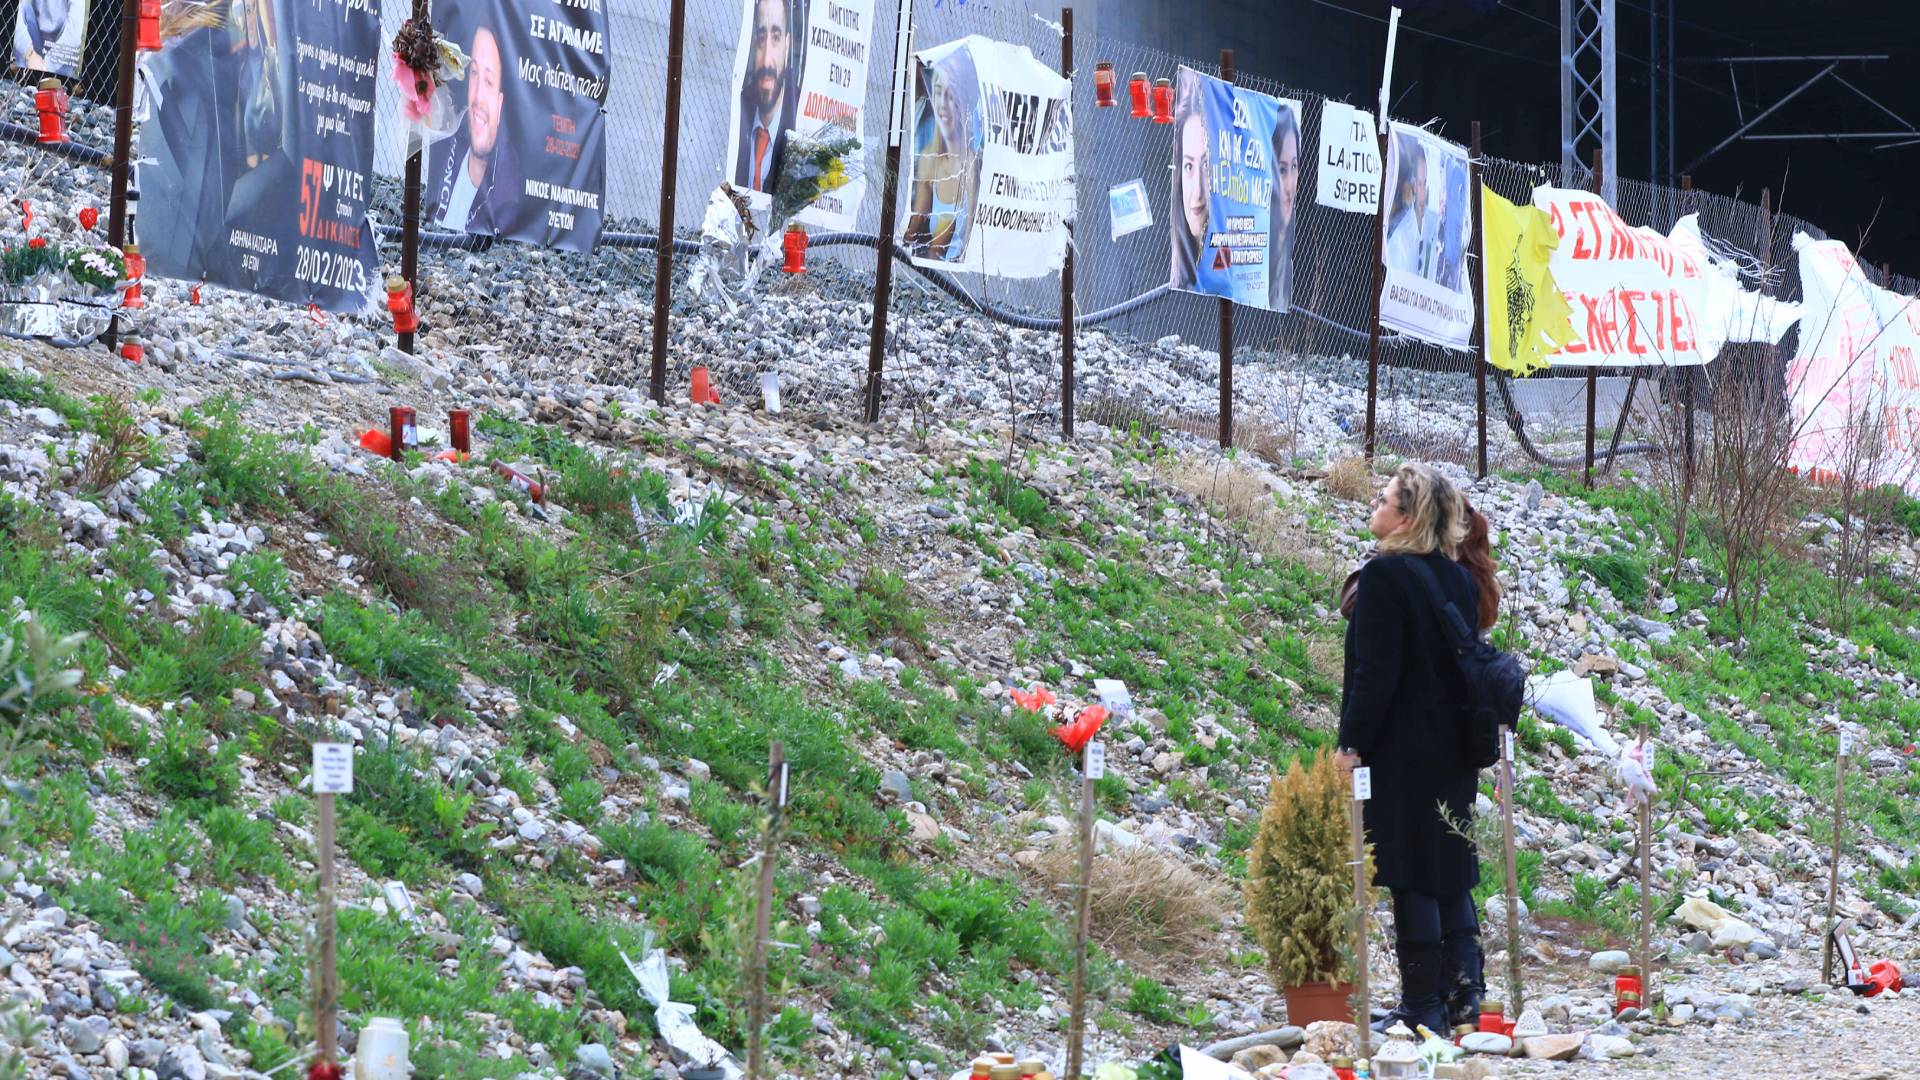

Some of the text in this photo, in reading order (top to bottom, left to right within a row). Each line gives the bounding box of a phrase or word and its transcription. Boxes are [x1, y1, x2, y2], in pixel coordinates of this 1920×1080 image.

[530, 14, 603, 54] ΣΕ ΑΓΑΠΑΜΕ
[519, 56, 542, 88] Μας
[576, 75, 604, 99] πολύ
[1328, 145, 1345, 168] LA
[299, 158, 363, 239] 57 ΨΥΧΕΣ
[525, 179, 549, 200] ΝΙΚΟΣ
[229, 229, 252, 249] ΑΘΗΝΑ
[295, 244, 366, 292] 28/02/2023
